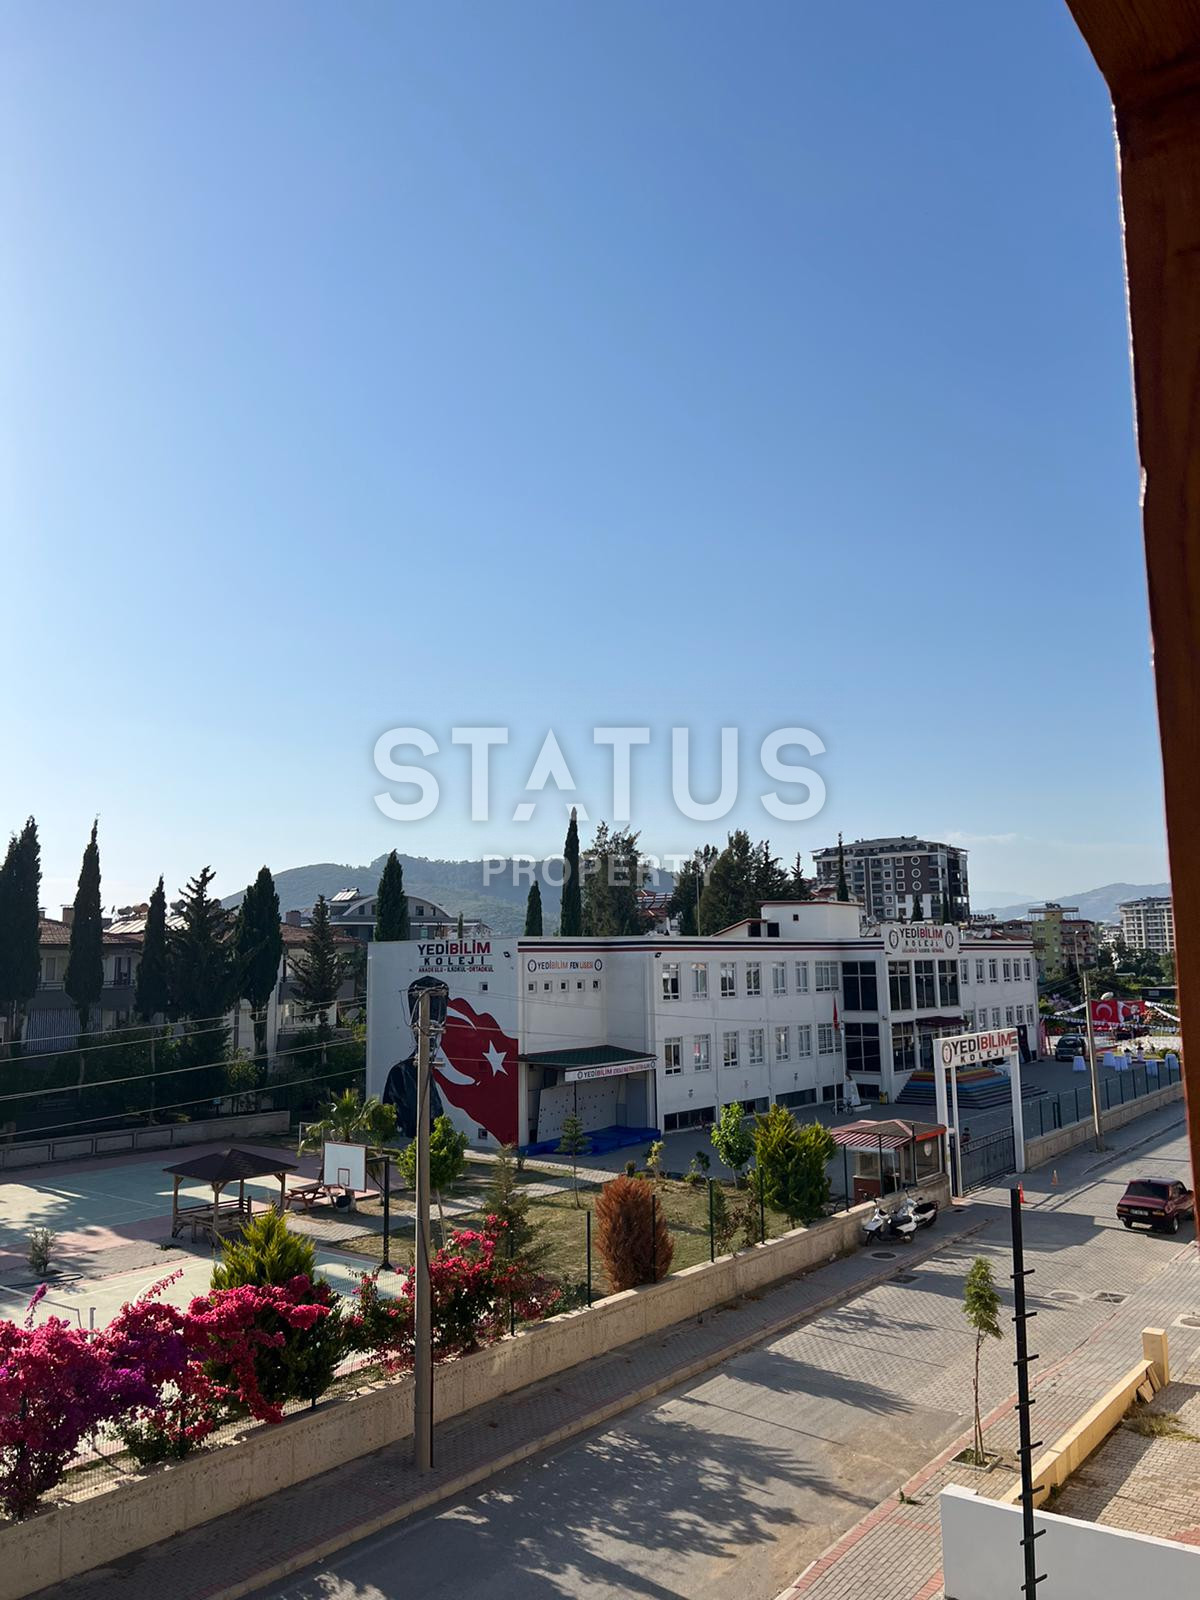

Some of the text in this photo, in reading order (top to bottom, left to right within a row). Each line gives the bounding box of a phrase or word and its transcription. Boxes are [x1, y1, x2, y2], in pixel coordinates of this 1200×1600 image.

[899, 926, 943, 938] YEDİBİLİM
[417, 940, 491, 955] YEDİBİLİM
[951, 1032, 1012, 1055] YEDİBİLİM
